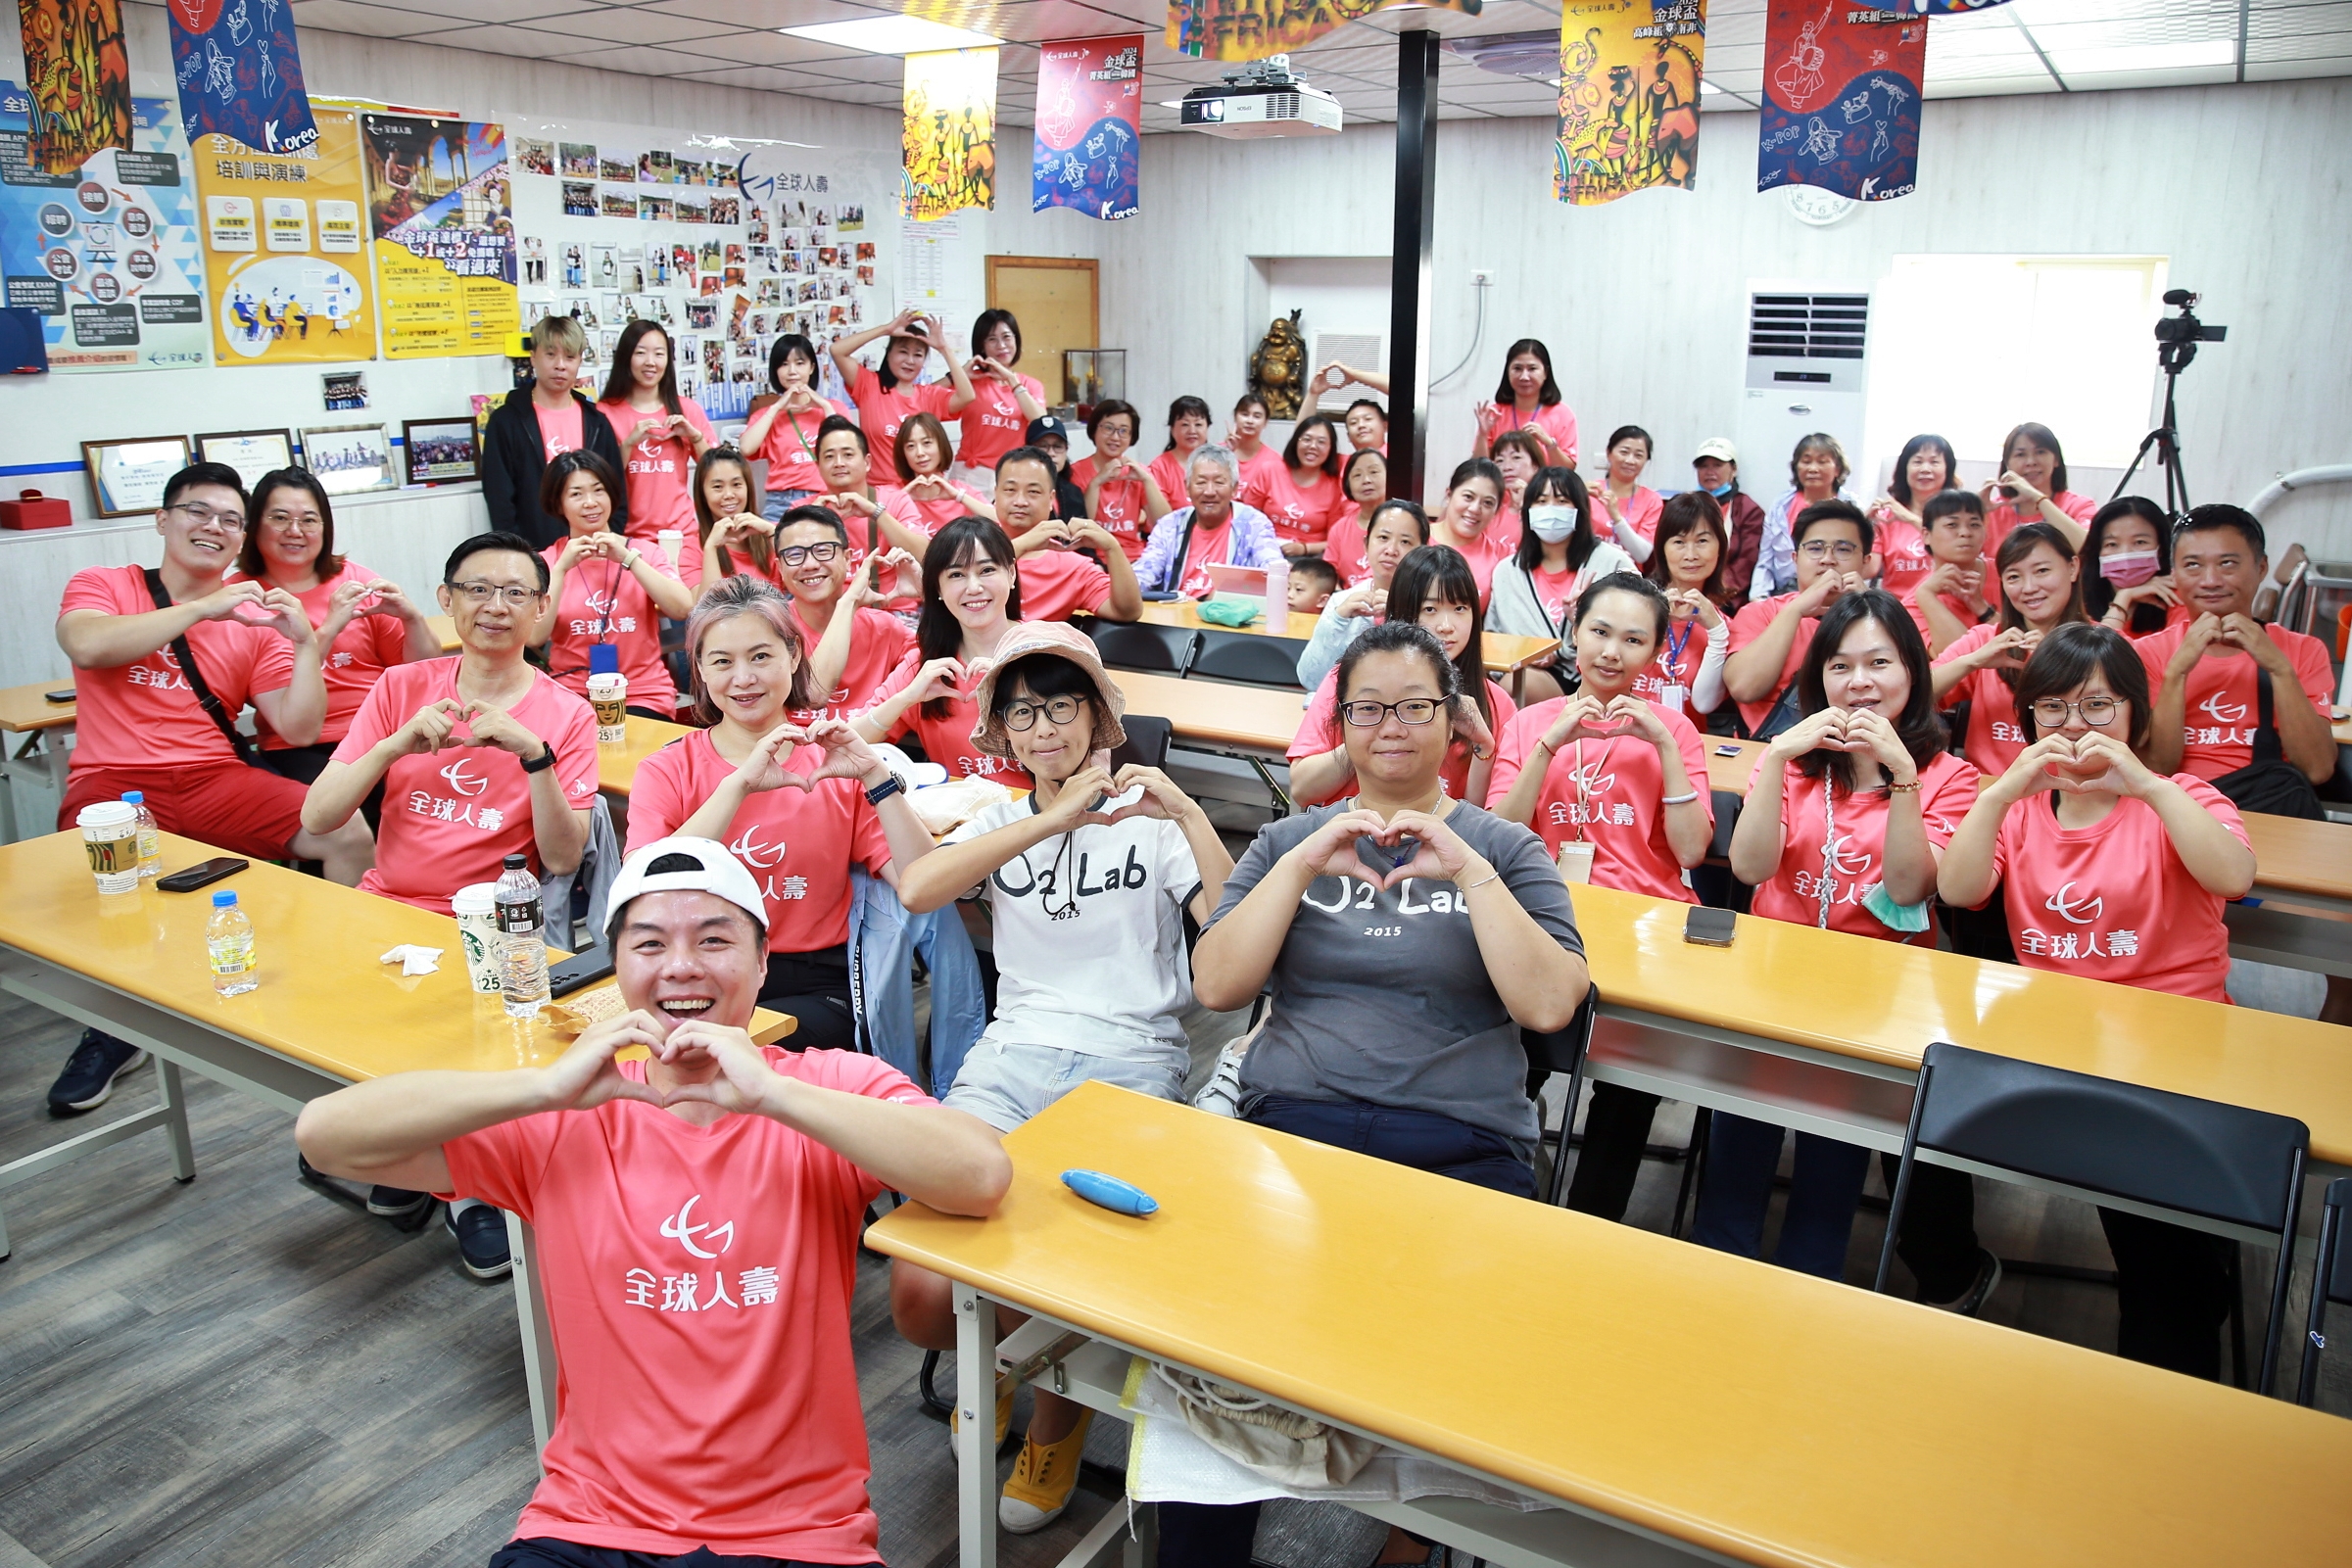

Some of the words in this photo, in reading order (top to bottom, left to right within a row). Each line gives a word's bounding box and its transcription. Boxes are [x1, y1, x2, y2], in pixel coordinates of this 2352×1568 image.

[1653, 5, 1699, 24] 金球盃
[1633, 25, 1663, 39] 高峰組
[1678, 23, 1698, 35] 南非
[1103, 54, 1136, 70] 金球盃
[264, 119, 320, 153] Korea
[1761, 125, 1800, 152] K-POP
[216, 160, 308, 183] 培訓與演練
[777, 172, 829, 194] 全球人壽
[1861, 177, 1916, 201] Korea
[1101, 200, 1139, 219] Korea
[628, 459, 675, 474] 全球人壽
[570, 616, 637, 636] 全球人壽
[127, 665, 194, 690] 全球人
[408, 789, 504, 832] 全球人壽
[1548, 801, 1635, 828] 全球人壽
[1077, 844, 1147, 898] Lab
[1051, 908, 1081, 922] 2015
[1363, 926, 1403, 937] 2015
[2021, 927, 2140, 959] 全球人壽
[481, 976, 501, 991] 25
[625, 1265, 780, 1312] 全球人壽
